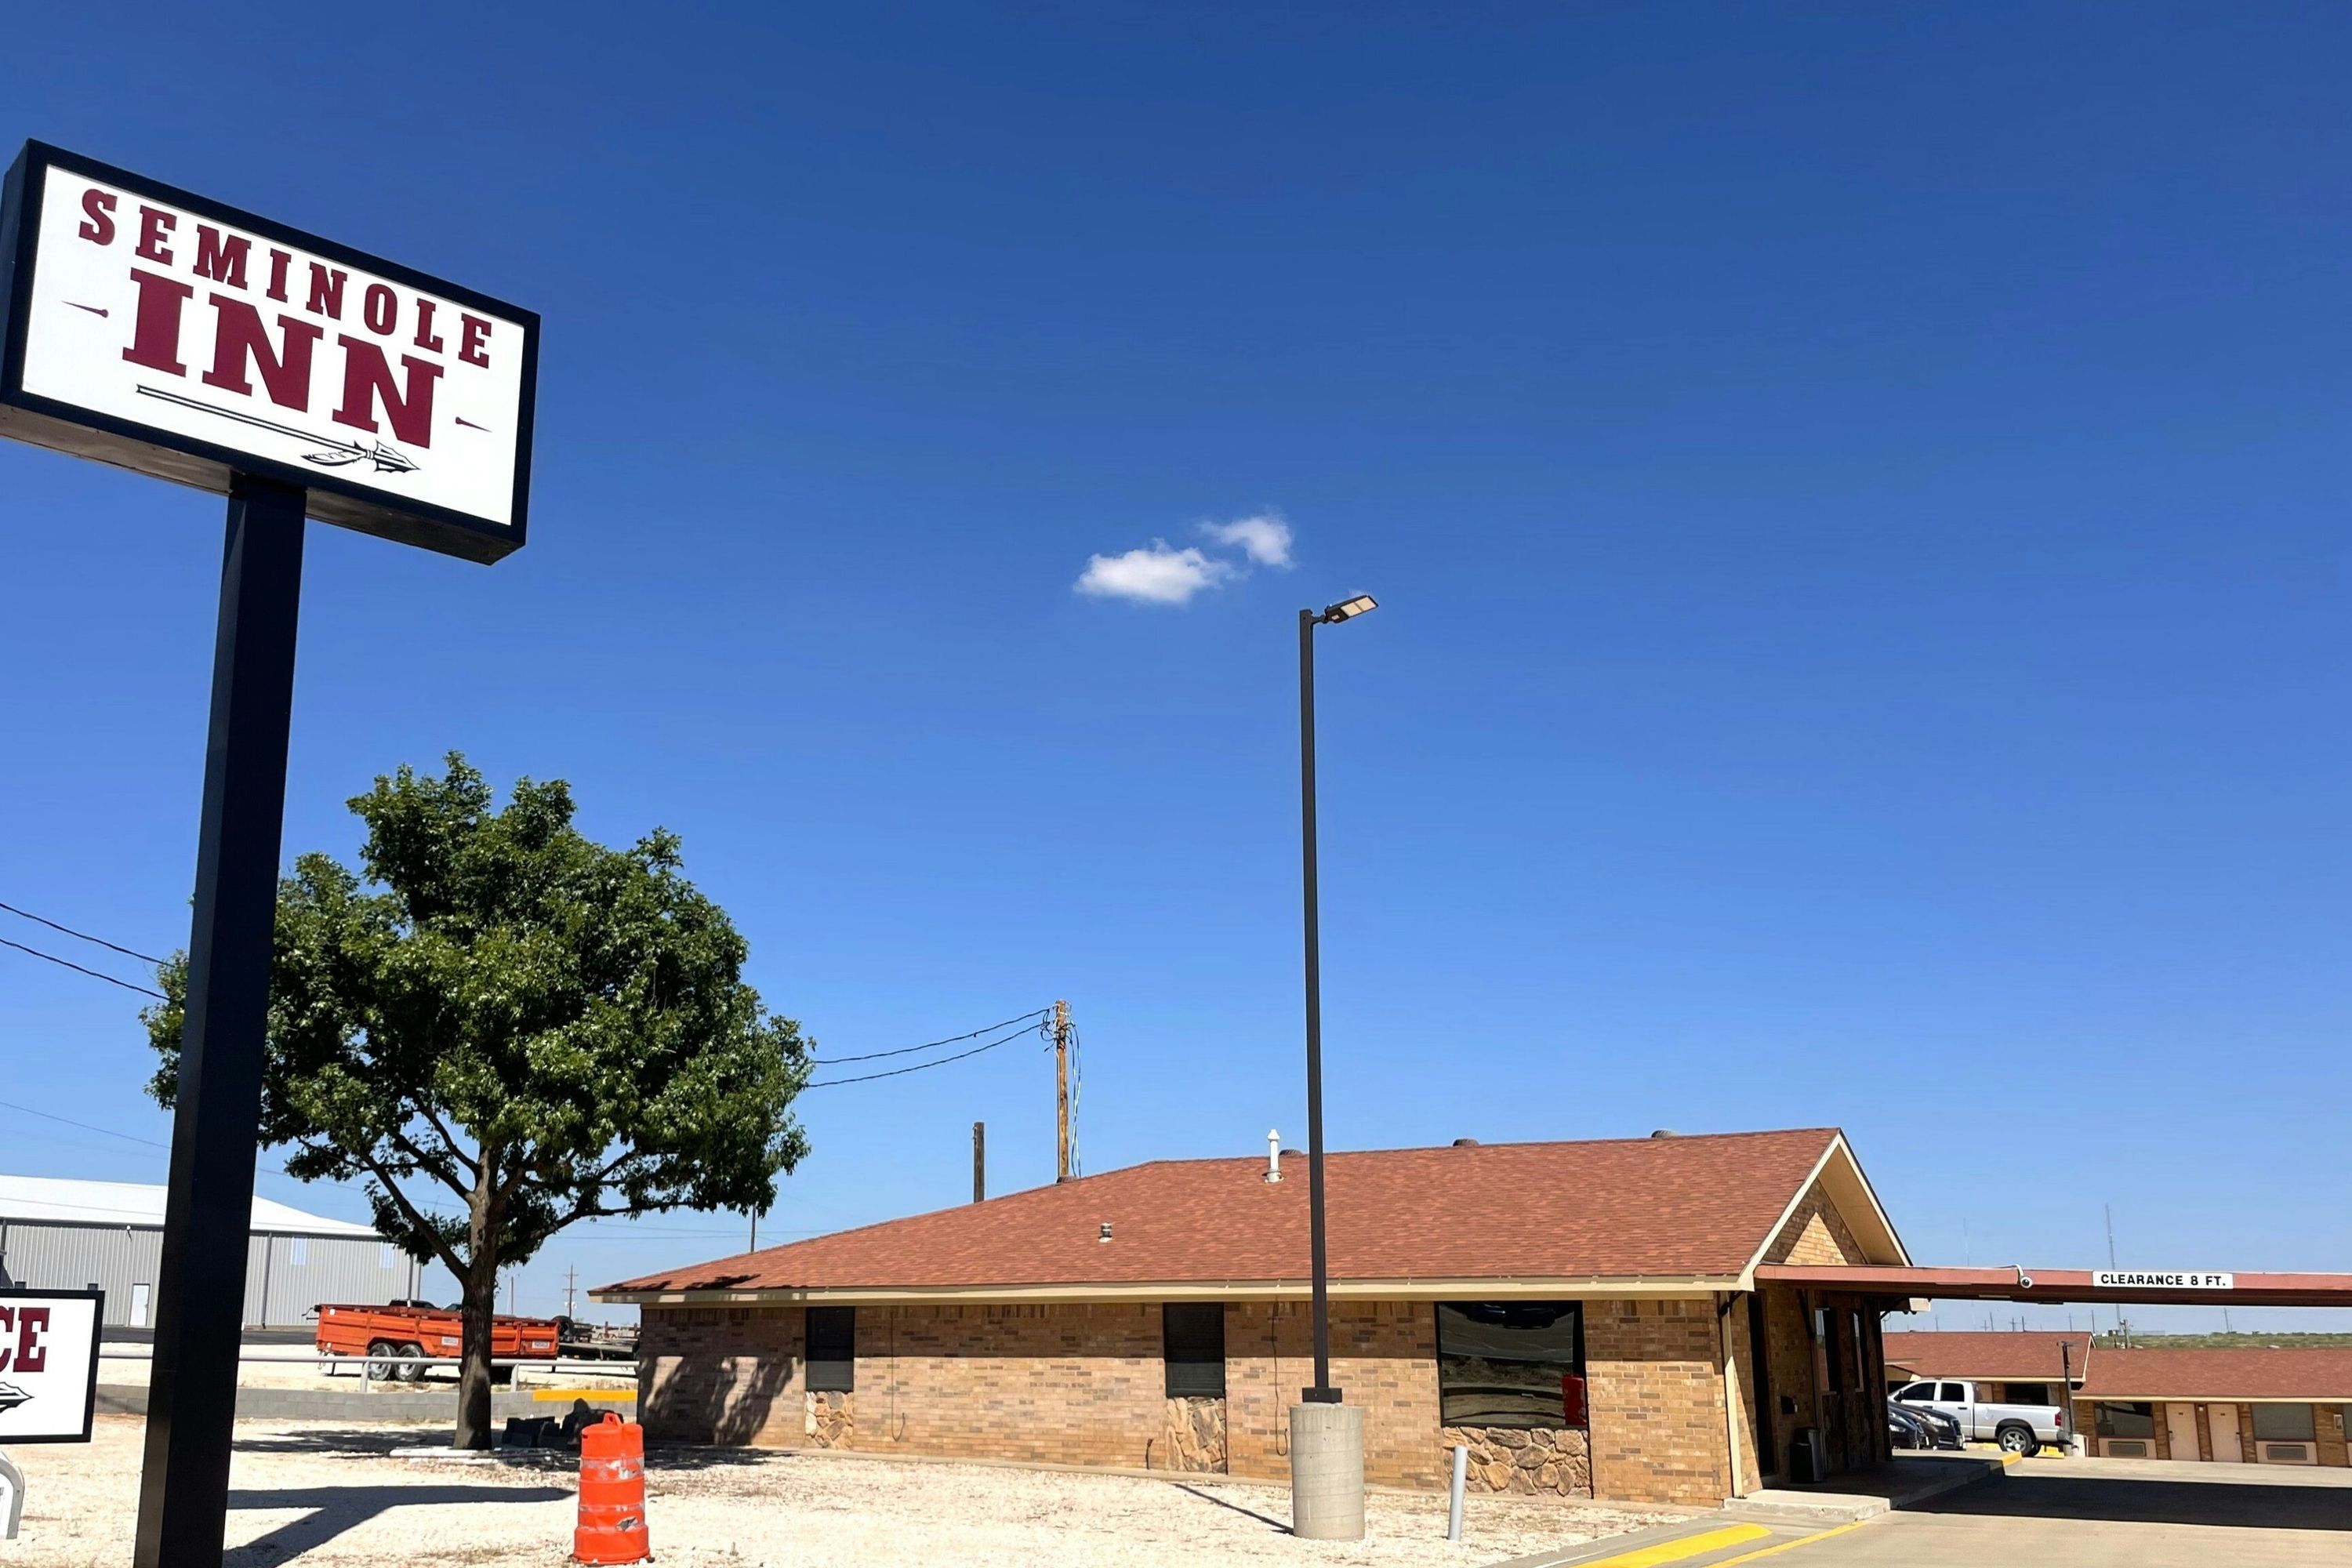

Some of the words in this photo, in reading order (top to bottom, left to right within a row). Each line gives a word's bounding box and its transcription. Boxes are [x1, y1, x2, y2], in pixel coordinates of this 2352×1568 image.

[78, 188, 492, 368] SEMINOLE
[122, 268, 445, 450] INN
[2100, 1274, 2183, 1286] CLEARANCE
[2190, 1275, 2198, 1286] 8
[2205, 1276, 2226, 1287] FT.
